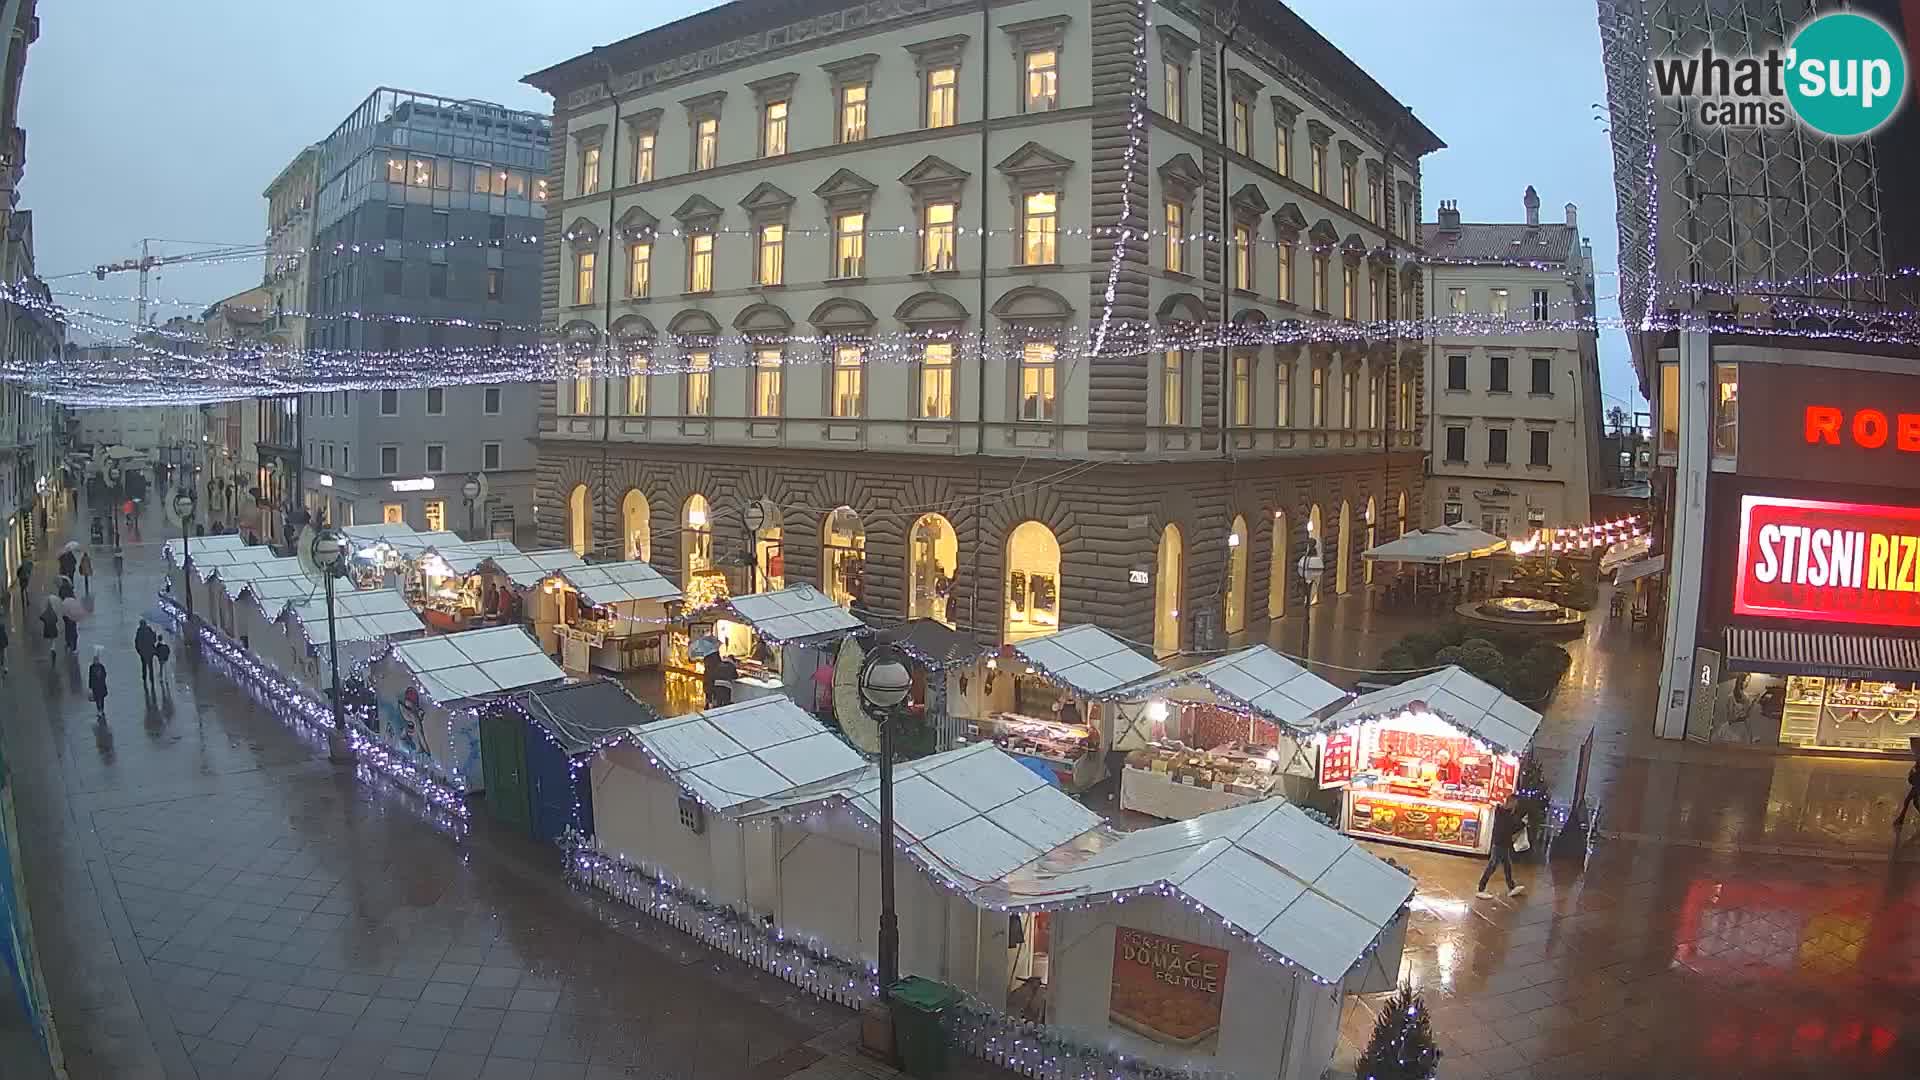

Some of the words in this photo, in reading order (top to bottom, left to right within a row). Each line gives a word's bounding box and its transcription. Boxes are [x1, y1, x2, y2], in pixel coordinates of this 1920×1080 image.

[1755, 524, 1865, 589] STISNI
[1124, 945, 1219, 980] DOMAĆE
[1156, 971, 1217, 993] FRITULE
